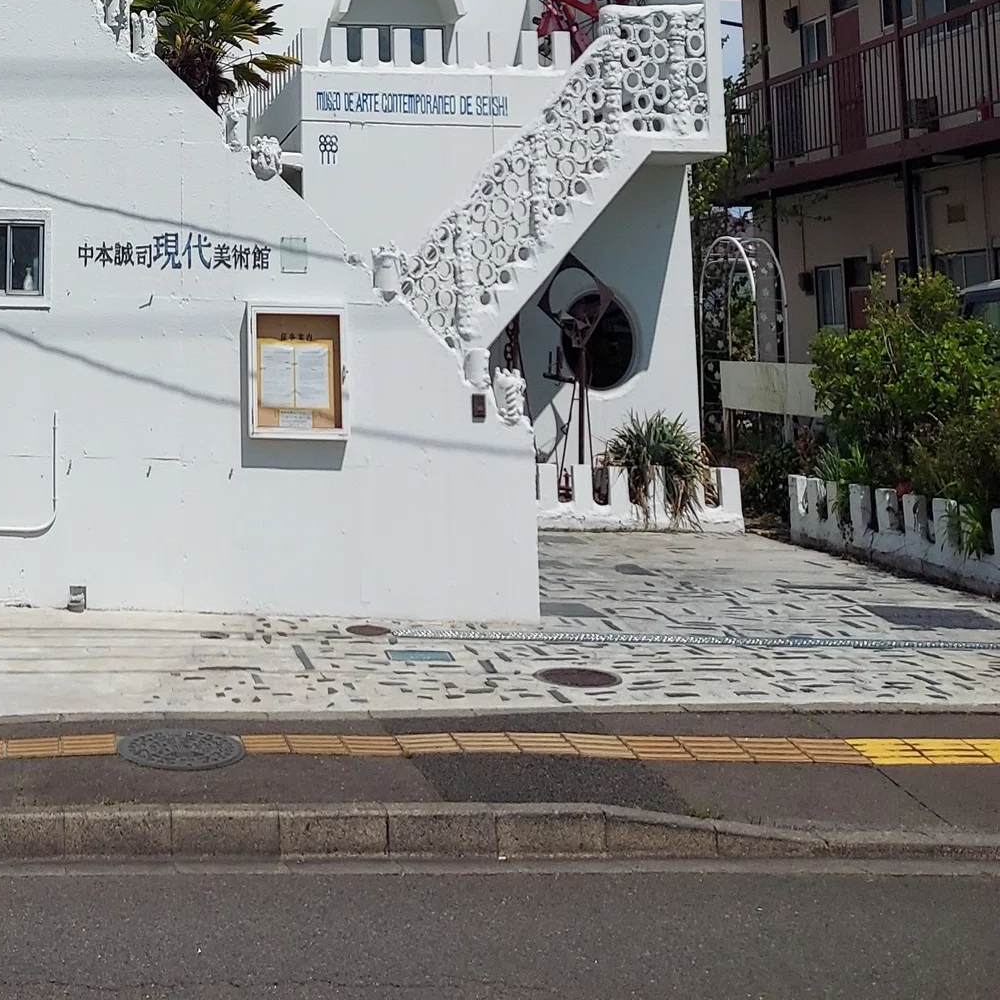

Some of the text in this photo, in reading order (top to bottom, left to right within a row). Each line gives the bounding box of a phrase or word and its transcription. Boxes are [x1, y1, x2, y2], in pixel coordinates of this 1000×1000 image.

[316, 91, 341, 111] MUSEO
[344, 92, 355, 112] DE
[356, 93, 380, 112] ARTE
[381, 93, 456, 114] CONTEMPORANEO
[460, 95, 473, 115] DE
[78, 232, 272, 270] 中本誠司現代美術館
